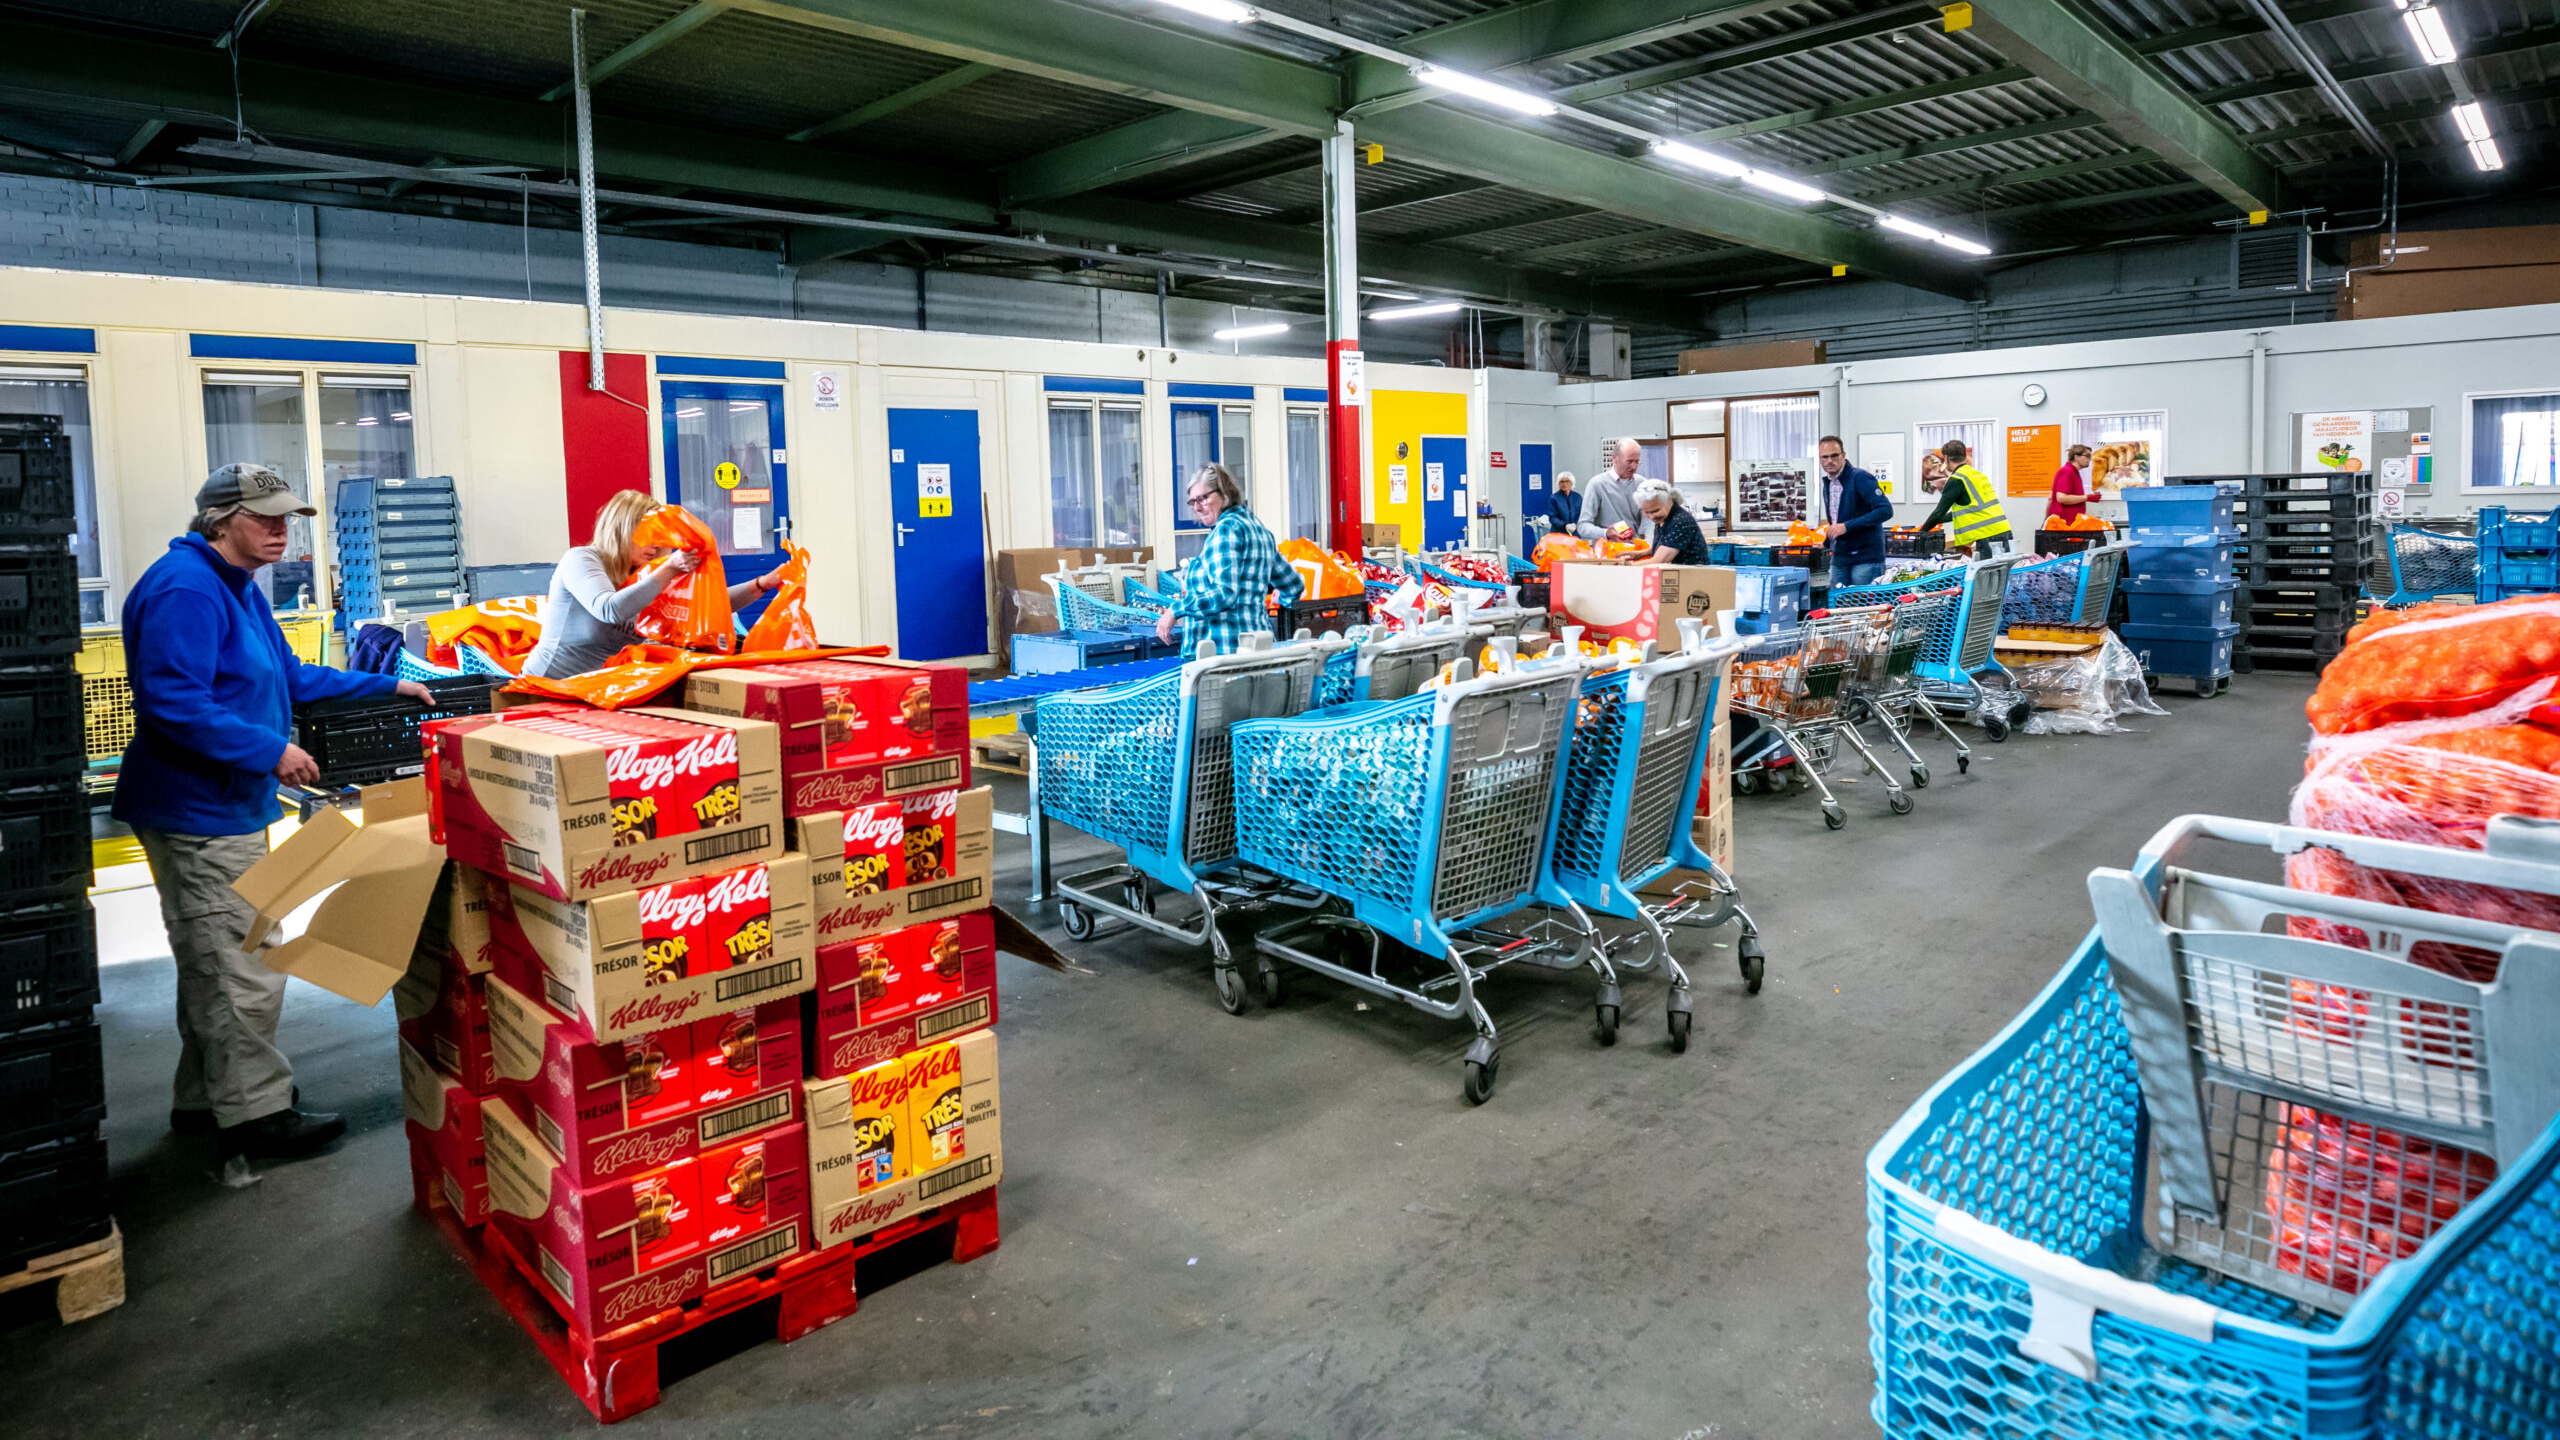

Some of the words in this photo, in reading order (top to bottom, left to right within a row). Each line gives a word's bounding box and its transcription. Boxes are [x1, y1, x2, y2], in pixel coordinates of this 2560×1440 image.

[2031, 428, 2040, 436] JE
[796, 774, 876, 807] Kellogg's
[563, 812, 607, 831] TRÉSOR
[611, 796, 658, 831] SOR
[579, 852, 670, 889] Kellogg's
[818, 902, 895, 934] Kellogg's
[595, 955, 638, 976] TRÉSOR
[643, 935, 690, 974] SOR
[609, 990, 701, 1031] Kellogg's
[834, 1026, 909, 1068] Kellogg's
[577, 1101, 621, 1122] TRÉSOR
[966, 1109, 997, 1126] ROULETTE
[970, 1099, 992, 1112] CHOCO
[854, 1113, 896, 1155] SOR
[594, 1127, 690, 1175] Kellogg's
[816, 1154, 853, 1173] TRÉSOR
[829, 1192, 905, 1235] Kellogg's
[588, 1246, 632, 1270] TRÉSOR
[604, 1267, 700, 1323] Kellogg's
